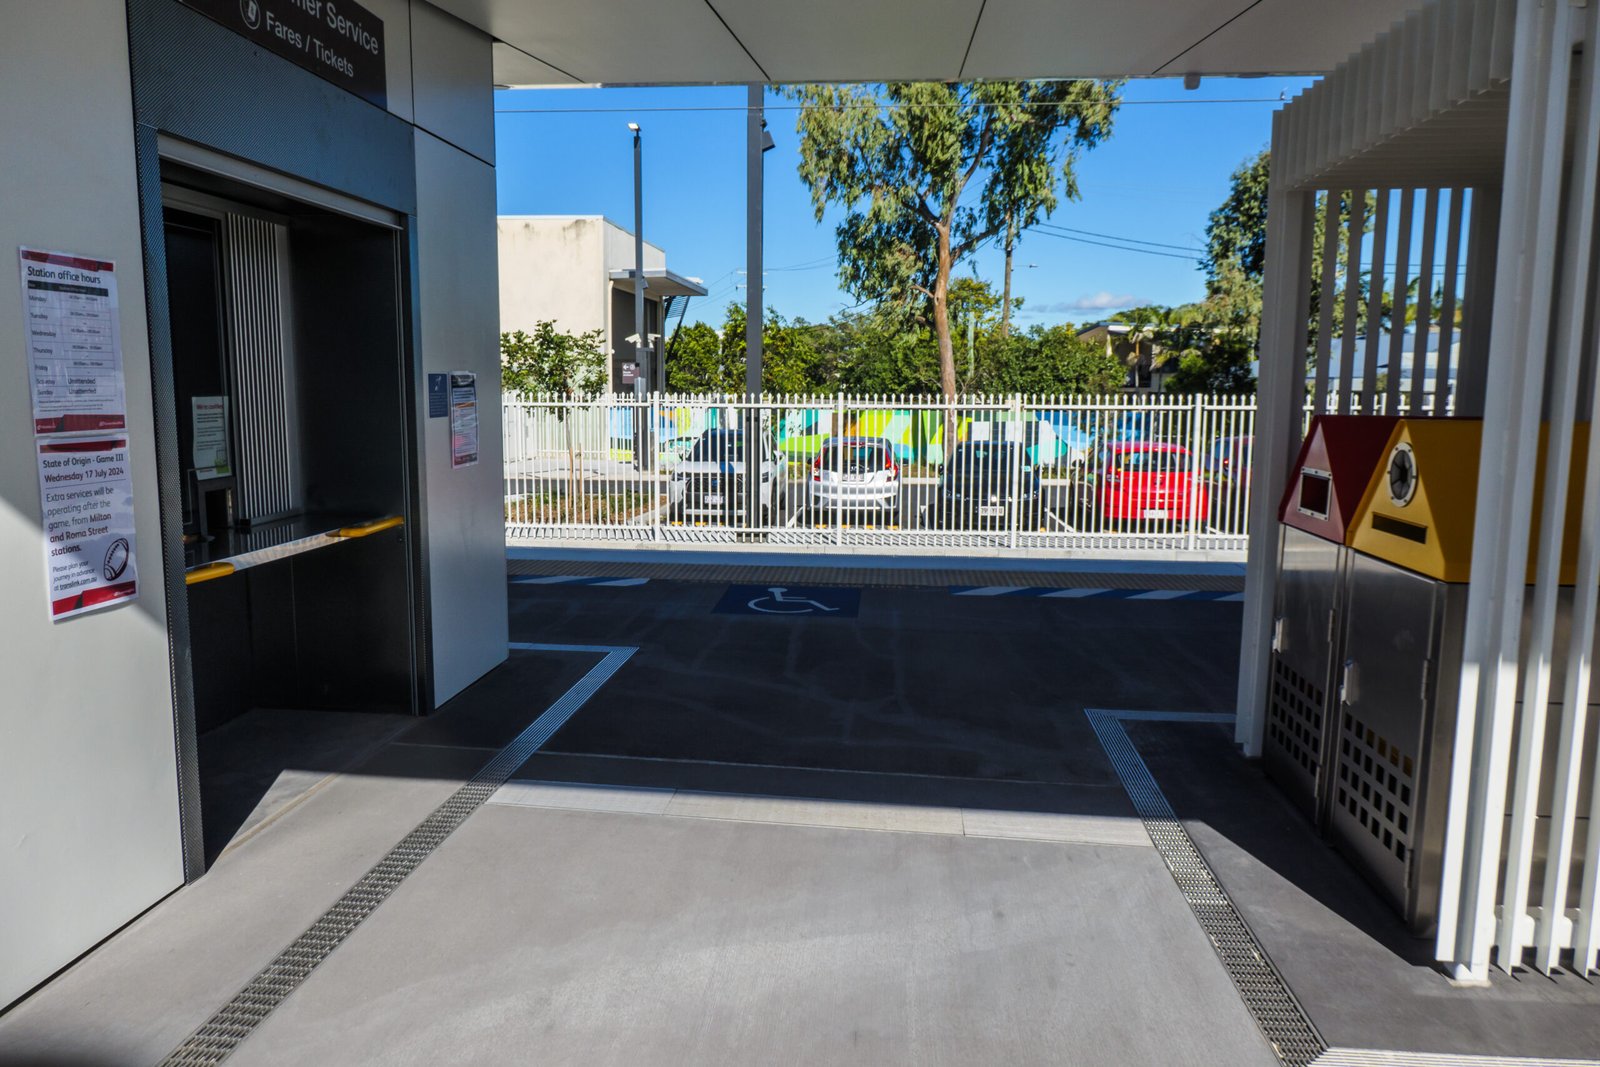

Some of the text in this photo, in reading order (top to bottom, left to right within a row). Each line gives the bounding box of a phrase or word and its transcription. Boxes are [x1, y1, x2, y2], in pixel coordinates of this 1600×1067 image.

[326, 2, 379, 55] Service
[265, 10, 354, 78] Fares / Tickets
[27, 266, 102, 284] Station office hours
[42, 459, 61, 468] State
[63, 458, 70, 466] of
[71, 457, 91, 467] Origin
[96, 456, 114, 464] Game
[115, 453, 124, 462] III
[44, 468, 124, 483] Wednesday 17 July 2024
[46, 487, 114, 502] Extra services will be
[47, 504, 81, 517] operating
[82, 501, 99, 510] after
[48, 513, 112, 532] game, from Milton
[49, 526, 109, 543] and Roma Street
[51, 544, 82, 557] stations.
[53, 561, 89, 573] Please plan your
[53, 574, 71, 584] journey
[76, 568, 96, 577] advance
[59, 576, 98, 591] translink.com.au
